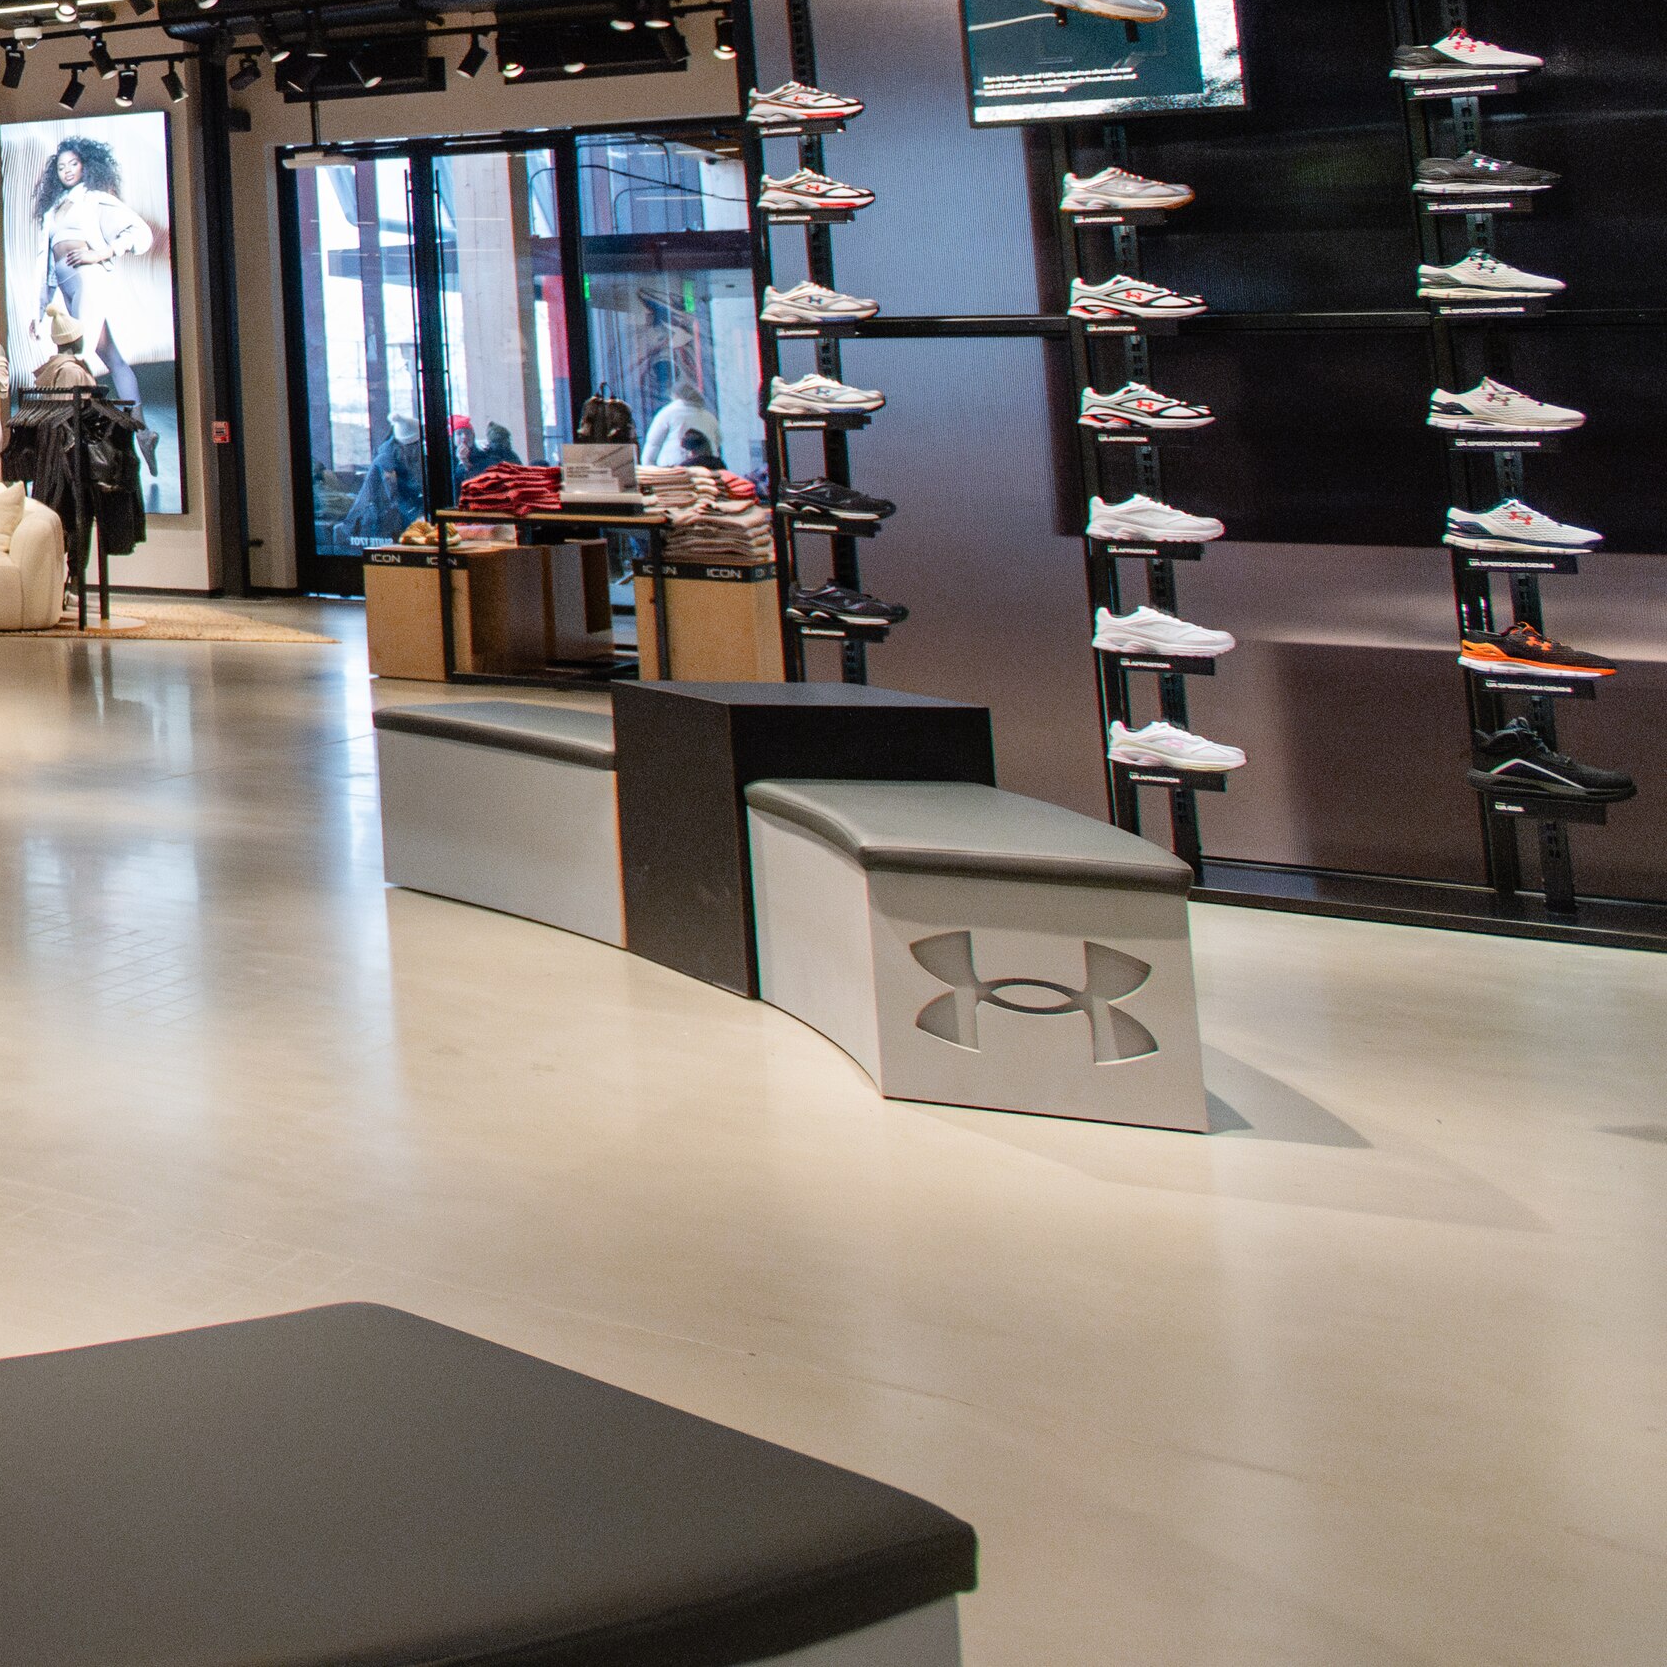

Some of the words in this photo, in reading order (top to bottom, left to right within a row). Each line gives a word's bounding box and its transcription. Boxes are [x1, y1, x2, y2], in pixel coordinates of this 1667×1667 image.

[371, 554, 401, 563] ICON
[426, 556, 458, 565] ICN
[707, 567, 742, 579] ICON
